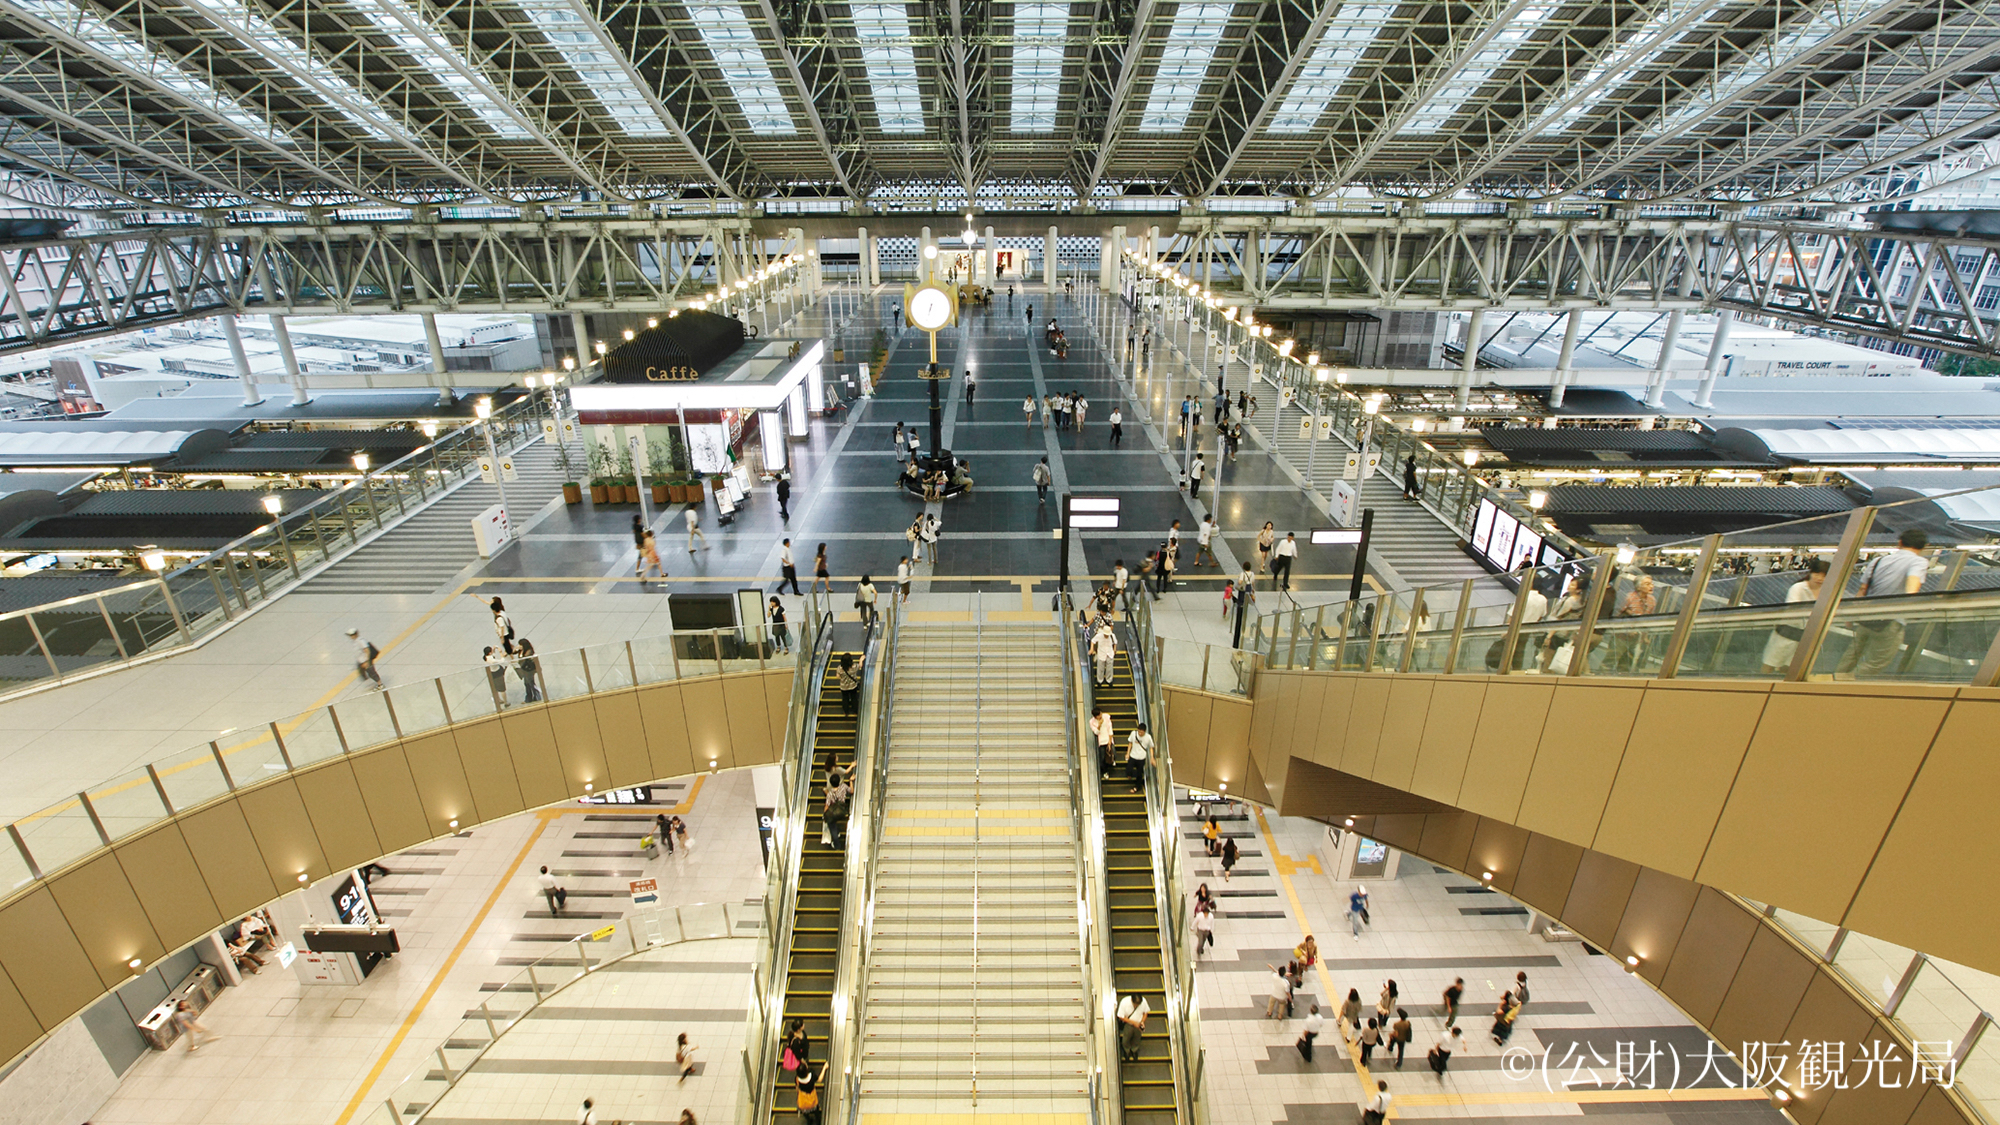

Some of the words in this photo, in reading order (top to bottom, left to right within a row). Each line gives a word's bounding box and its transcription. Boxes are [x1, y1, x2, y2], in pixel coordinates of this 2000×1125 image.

[1777, 361, 1804, 369] TRAVEL
[1806, 361, 1832, 369] COURT
[646, 366, 699, 381] Caffè
